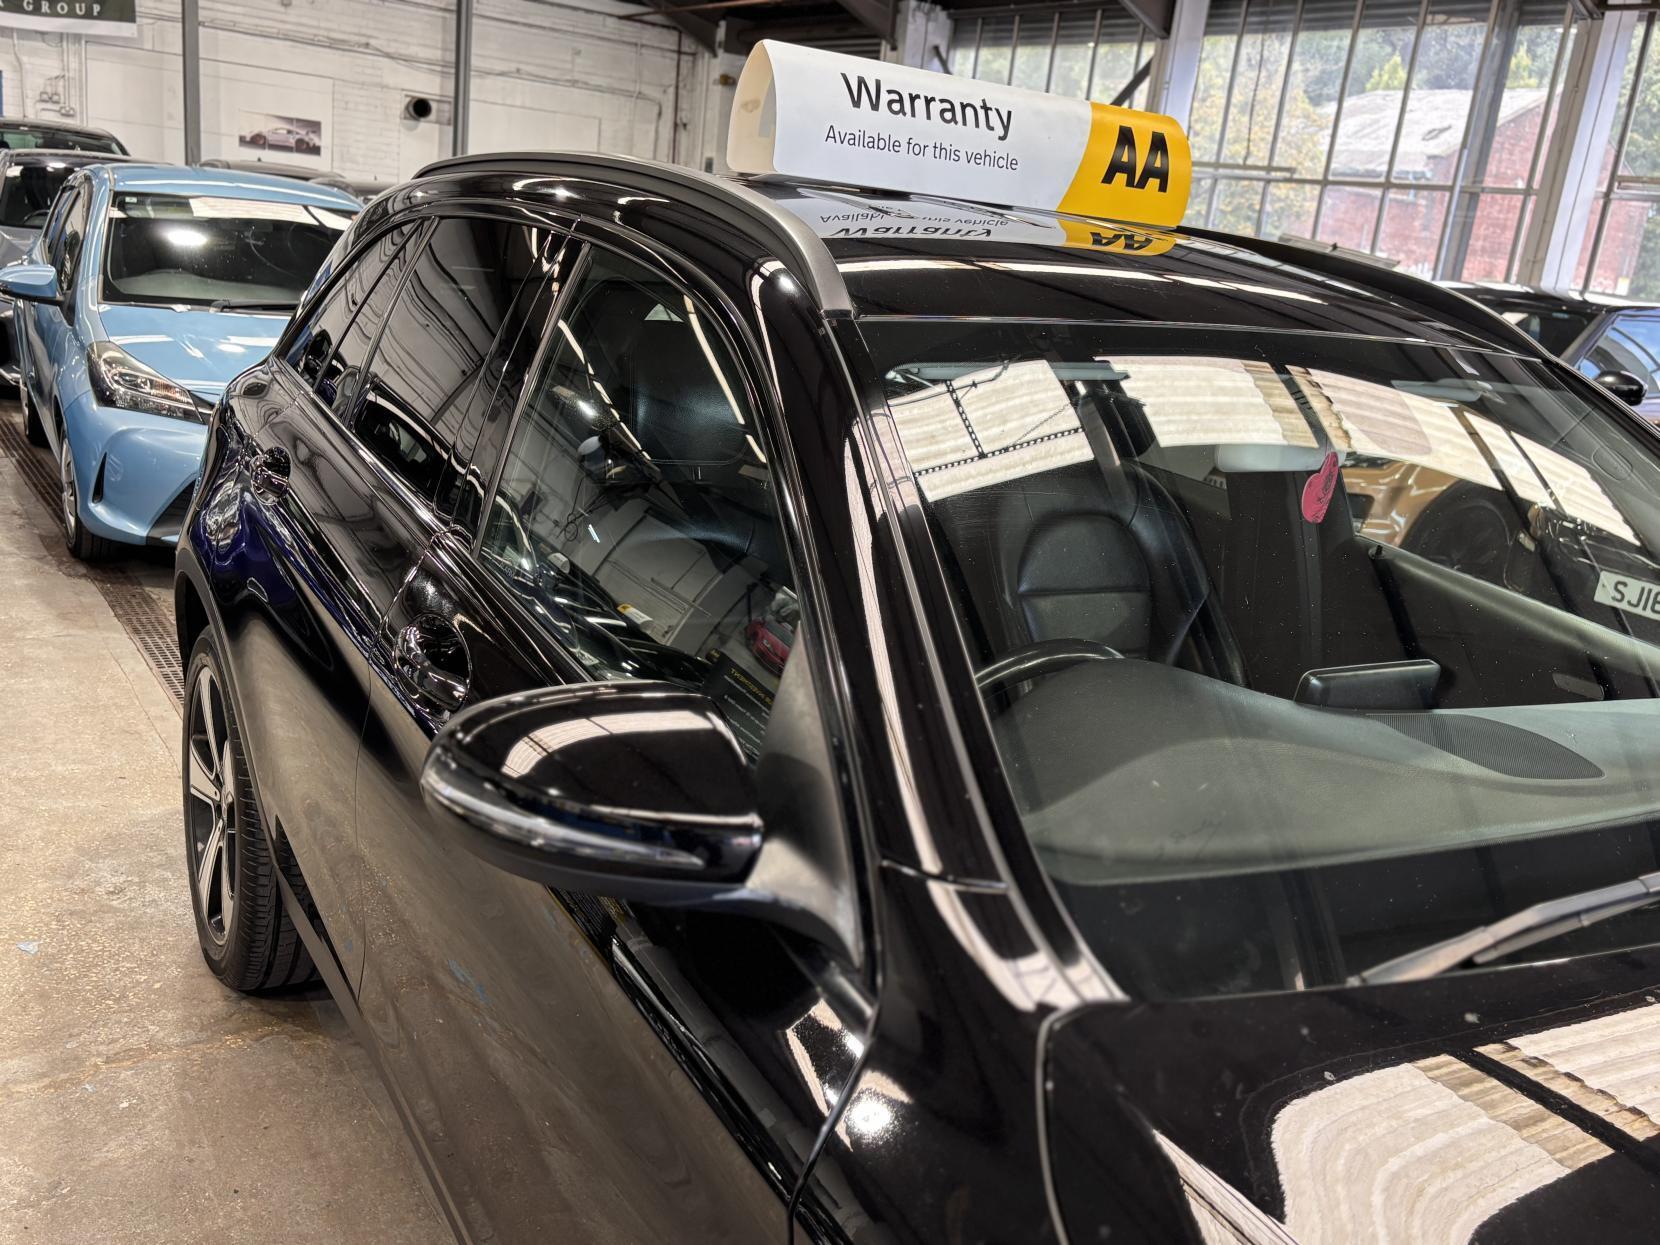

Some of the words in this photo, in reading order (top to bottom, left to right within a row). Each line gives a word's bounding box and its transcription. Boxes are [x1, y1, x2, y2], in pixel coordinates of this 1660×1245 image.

[23, 0, 102, 16] GROUP
[840, 72, 1012, 141] Warranty
[824, 124, 902, 153] Available
[906, 137, 929, 158] for
[932, 141, 961, 162] this
[965, 149, 1019, 171] vehicle
[1101, 125, 1170, 193] AA
